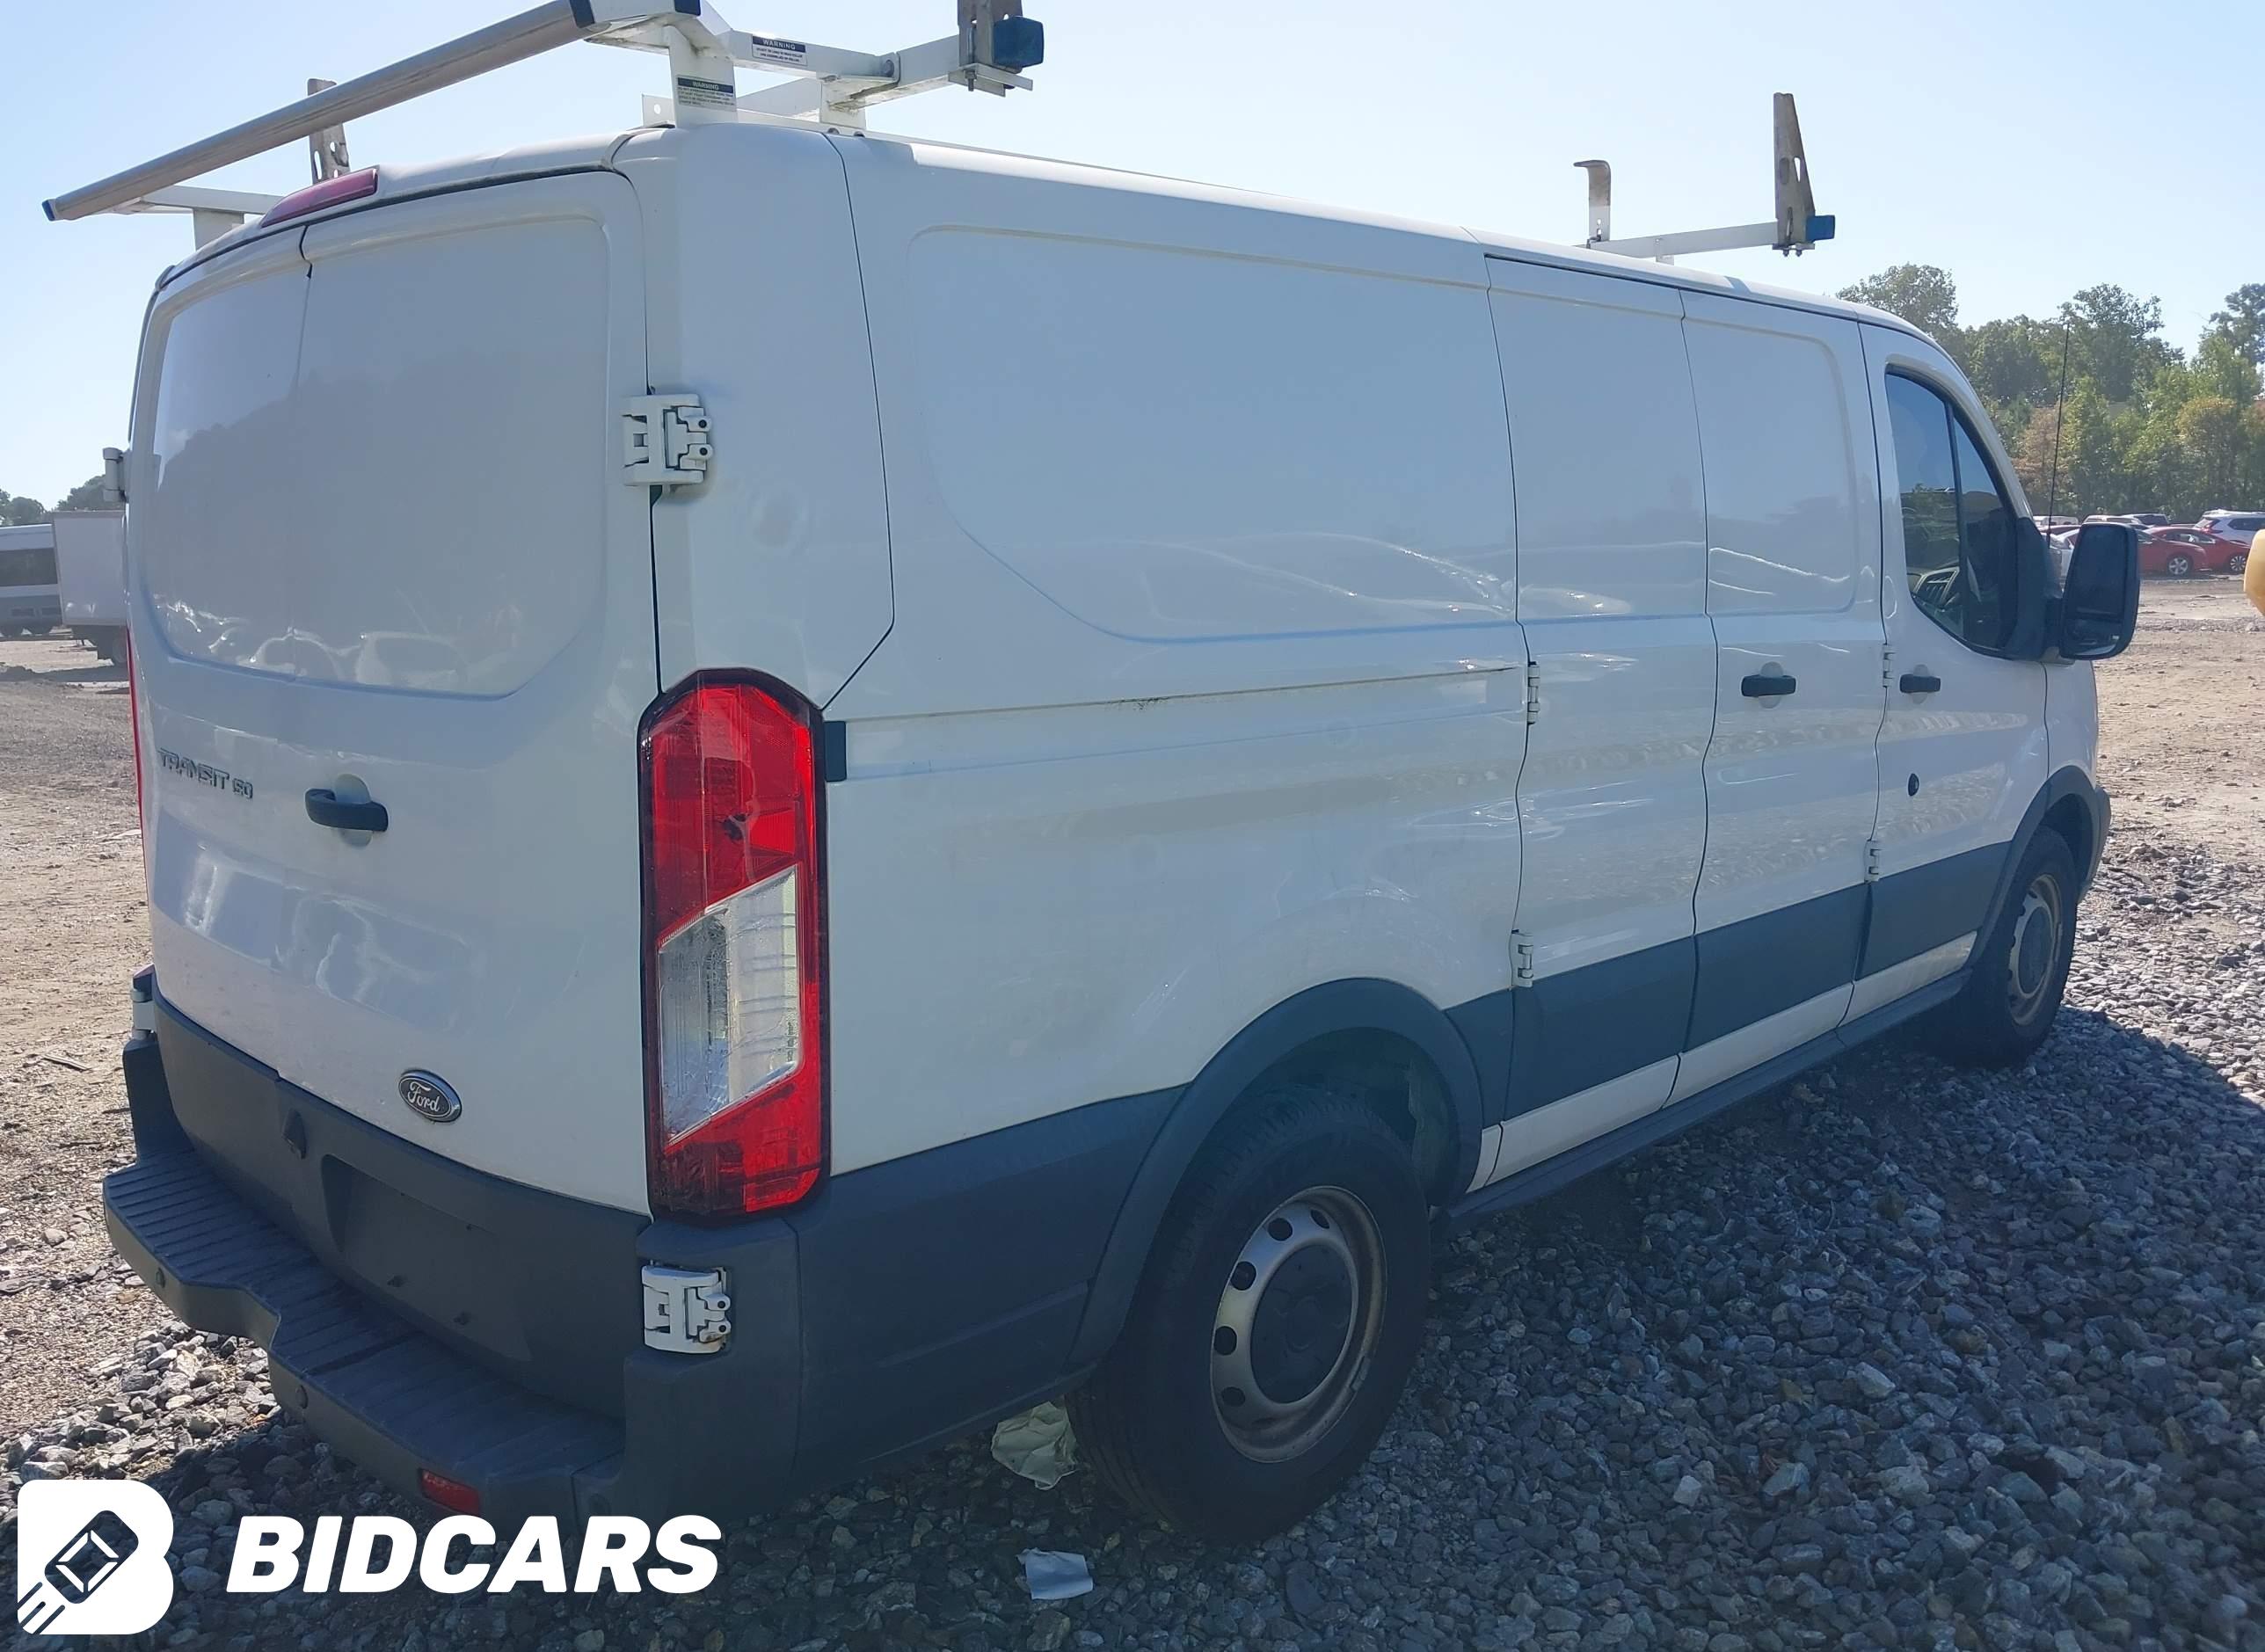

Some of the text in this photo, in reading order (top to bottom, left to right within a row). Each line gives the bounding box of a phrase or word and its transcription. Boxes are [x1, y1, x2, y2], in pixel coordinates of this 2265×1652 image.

[762, 39, 796, 50] WARNING
[692, 81, 719, 91] WARNING
[157, 747, 229, 790] TRANSIT
[407, 1081, 441, 1111] Ford
